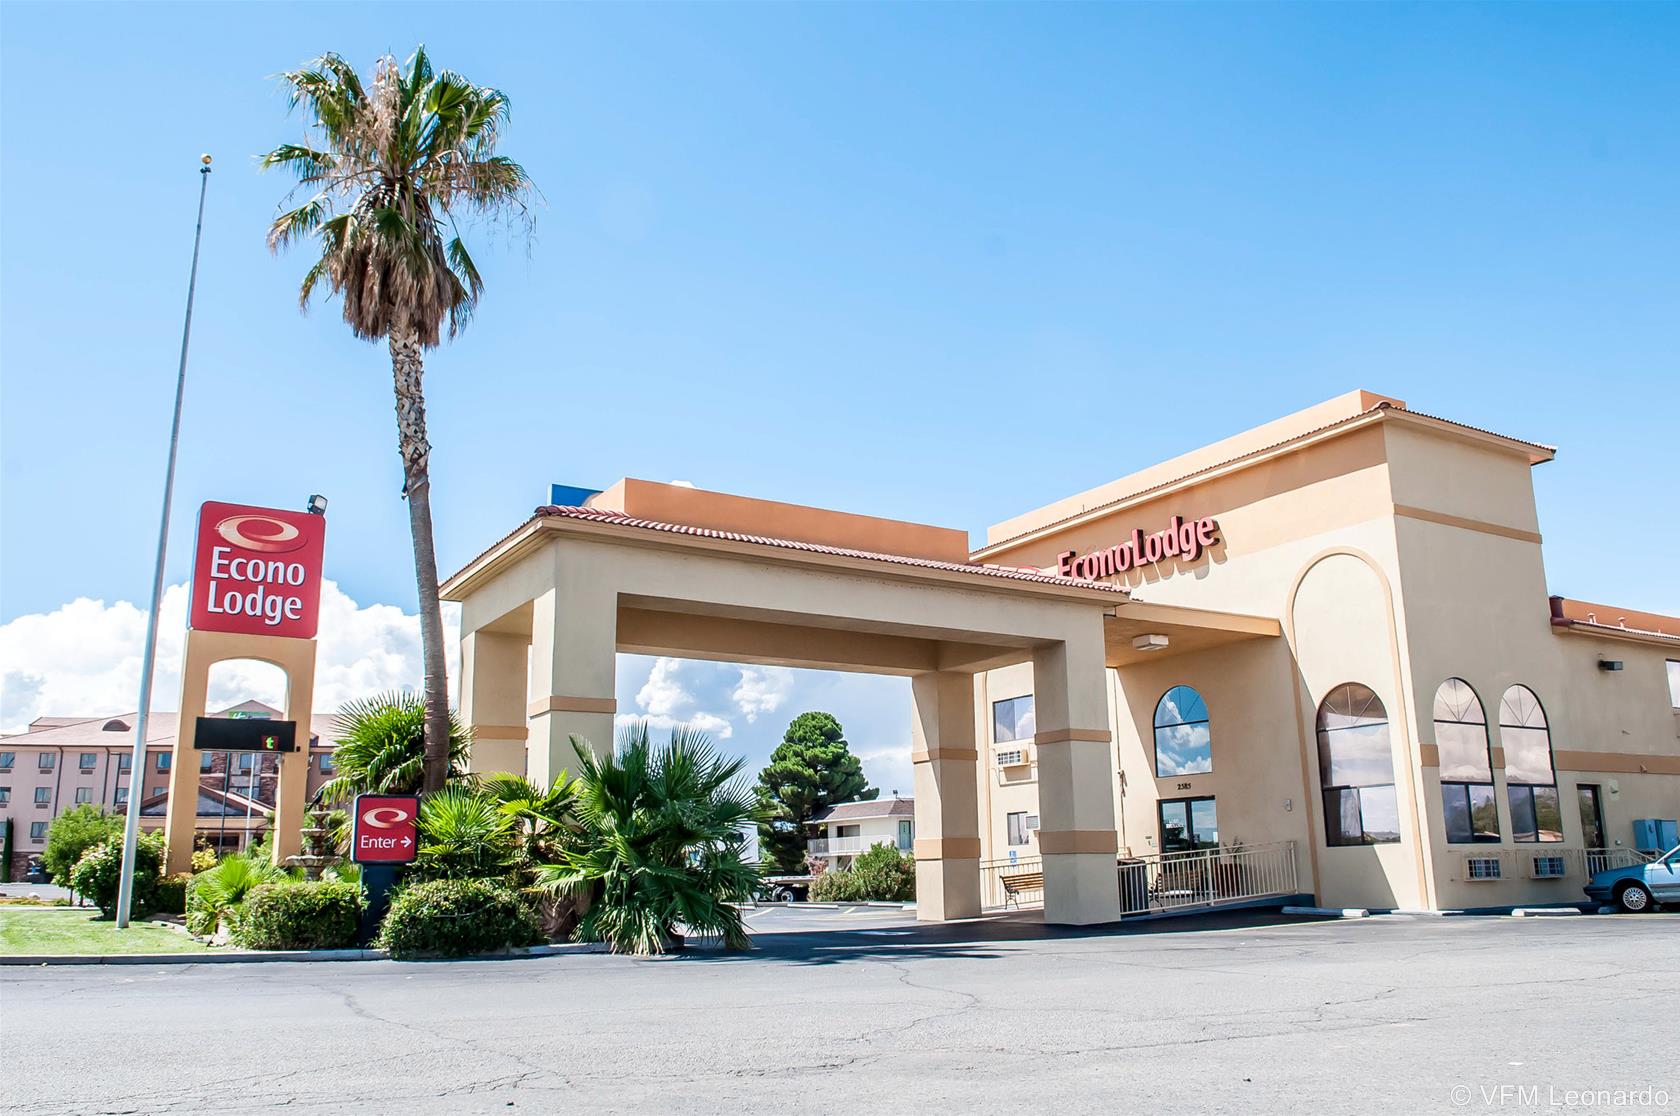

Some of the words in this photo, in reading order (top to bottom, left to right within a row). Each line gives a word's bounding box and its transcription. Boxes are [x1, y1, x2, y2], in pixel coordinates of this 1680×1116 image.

[210, 545, 305, 586] Econo
[1057, 515, 1220, 581] EconoLodge
[207, 580, 302, 626] Lodge
[360, 834, 397, 849] Enter
